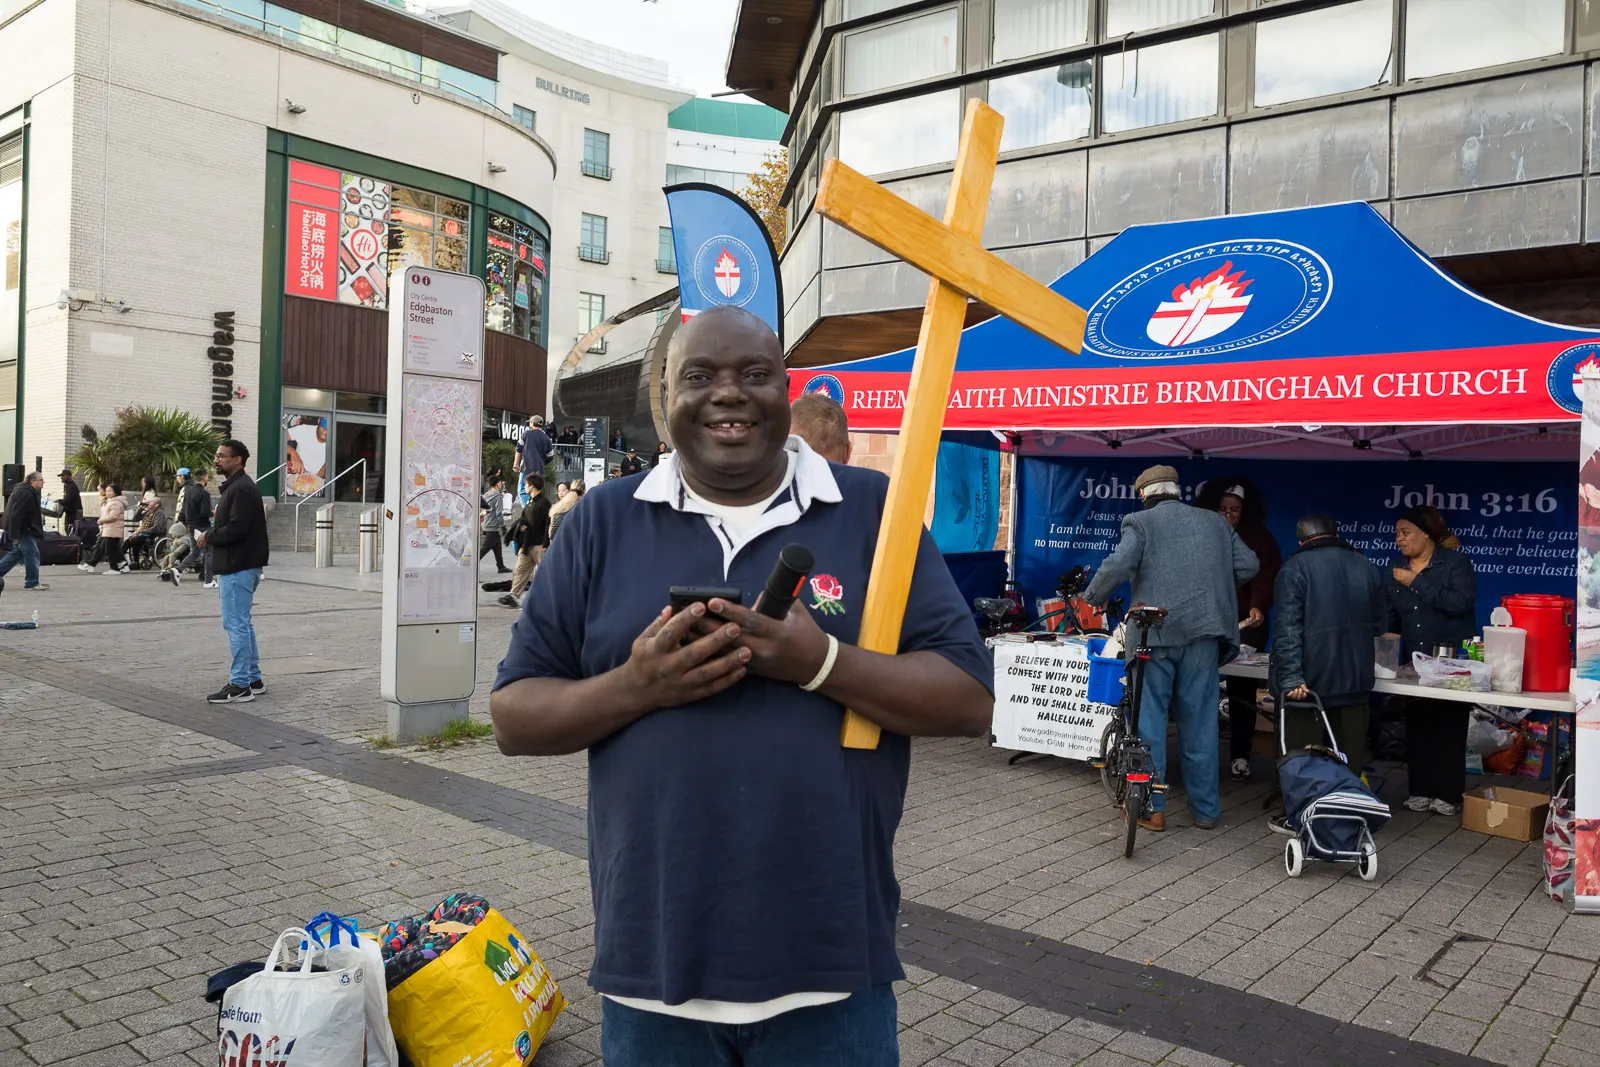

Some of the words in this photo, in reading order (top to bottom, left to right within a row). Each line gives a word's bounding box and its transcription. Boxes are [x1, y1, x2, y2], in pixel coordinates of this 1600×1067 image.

[536, 76, 590, 105] BULLRING
[301, 209, 311, 250] Haidilao
[310, 211, 326, 290] 海底捞火锅
[300, 252, 310, 269] Hot
[300, 270, 310, 288] Pot
[410, 292, 420, 301] City
[421, 294, 438, 303] Centre
[410, 301, 453, 316] Edgbaston
[410, 313, 434, 325] Street
[1176, 329, 1281, 356] BIRMINGHAM
[1281, 297, 1319, 329] CHURCH
[947, 388, 1006, 409] AITH
[1011, 382, 1149, 408] MINISTRIE
[1155, 374, 1364, 404] BIRMINGHAM
[1372, 368, 1528, 399] CHURCH
[1384, 484, 1470, 510] John
[1480, 488, 1558, 516] 3:16
[1087, 510, 1115, 521] Jesus
[1050, 523, 1055, 534] I
[1056, 526, 1073, 534] am
[1075, 524, 1092, 535] the
[1094, 528, 1118, 538] way,
[1360, 524, 1375, 533] so
[1492, 525, 1524, 539] that
[1526, 527, 1545, 539] he
[1548, 530, 1578, 543] gav
[1034, 539, 1046, 547] no
[1048, 540, 1070, 549] man
[1072, 540, 1108, 550] cometh
[1516, 544, 1578, 559] believet
[1015, 655, 1050, 667] BELIEVE
[1053, 659, 1063, 667] IN
[1007, 667, 1042, 679] CONFESS
[1046, 672, 1068, 682] WITH
[1071, 674, 1089, 685] YOU
[1031, 683, 1047, 693] THE
[1050, 685, 1072, 697] LORD
[1075, 689, 1088, 699] JE
[1010, 694, 1029, 705] AND
[1032, 697, 1049, 707] YOU
[1051, 699, 1077, 711] SHALL
[1080, 703, 1092, 713] BE
[1095, 705, 1116, 716] SAVE
[1037, 711, 1095, 728] HALLELUJAH.
